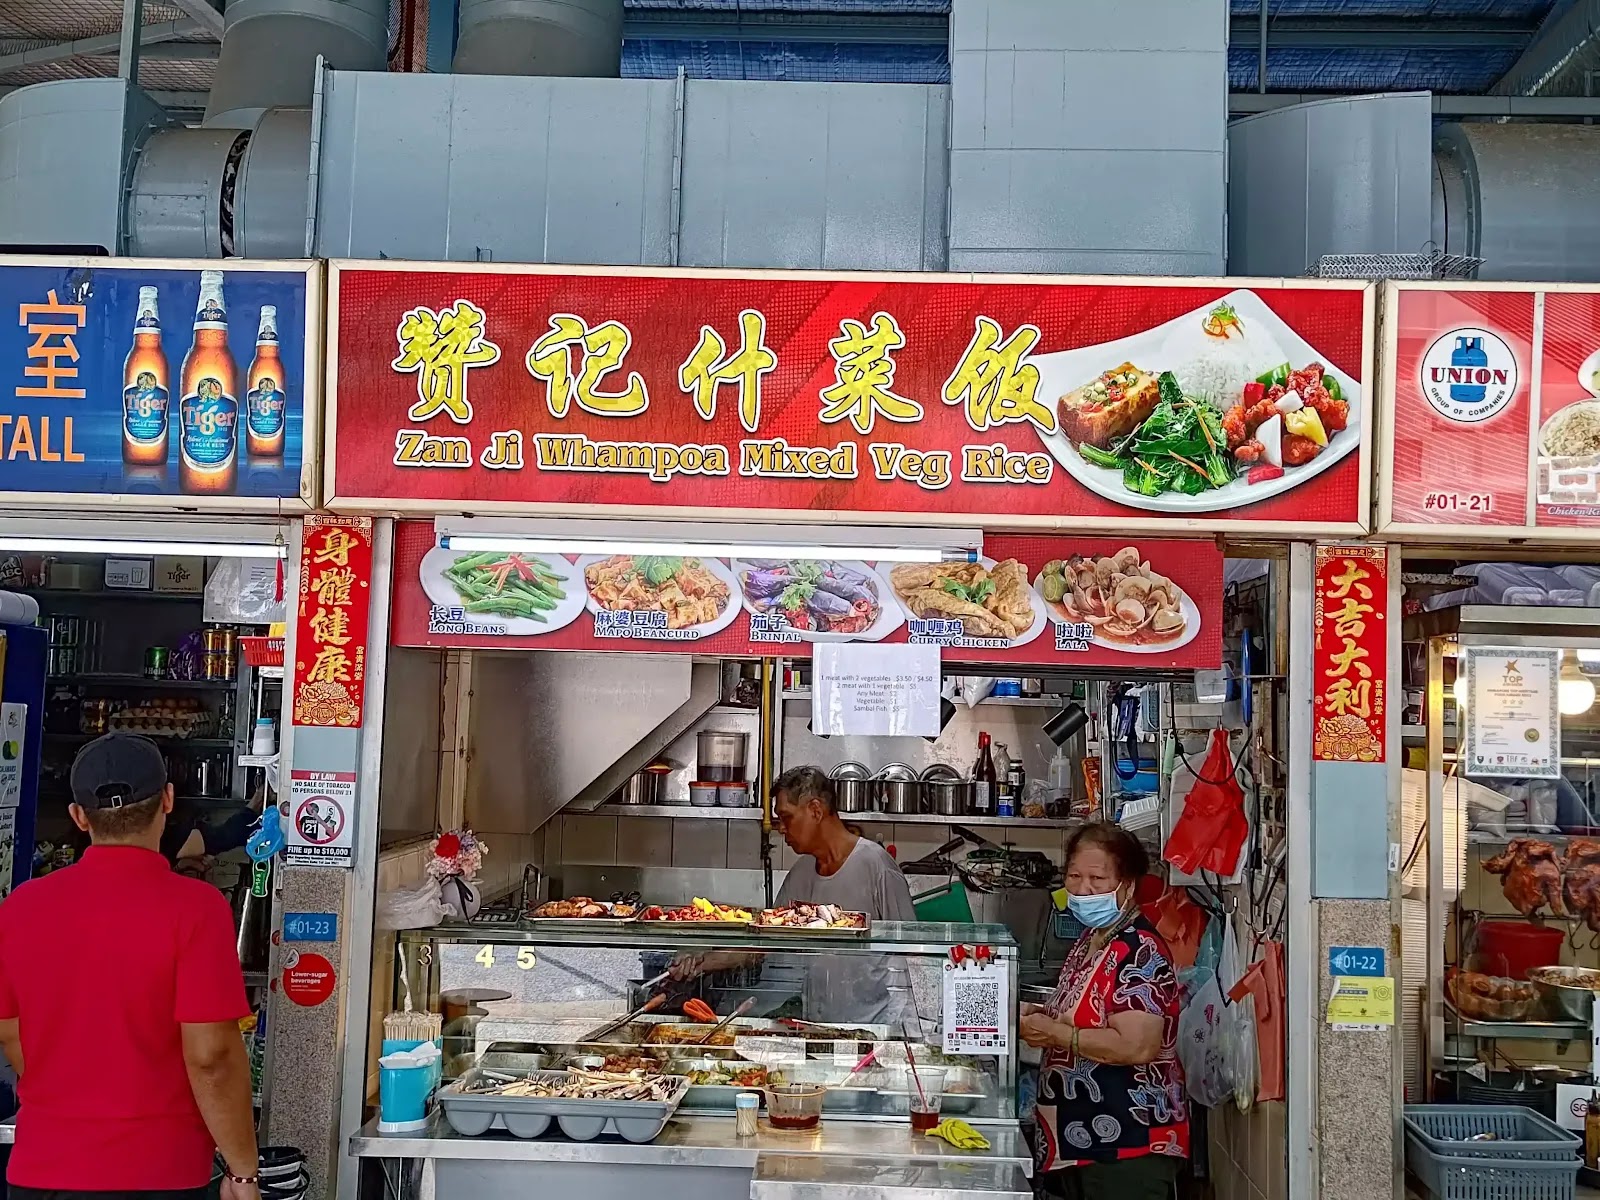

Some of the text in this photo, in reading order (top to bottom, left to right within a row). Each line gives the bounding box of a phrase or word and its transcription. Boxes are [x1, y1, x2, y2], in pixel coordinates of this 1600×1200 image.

[16, 289, 86, 399] 室
[392, 299, 1059, 435] 赞记什菜饭
[1430, 367, 1508, 385] UNION
[126, 393, 167, 417] Tiger
[250, 395, 283, 416] Tiger
[1431, 387, 1450, 408] GROUP
[1469, 389, 1505, 416] COMPANIES
[183, 405, 235, 435] Tiger
[396, 431, 1052, 487] Zan Ji Whampoa Mixed Veg Rice
[1425, 494, 1491, 511] #01-21
[306, 527, 359, 683] 身體健康
[430, 605, 465, 622] 长豆
[596, 611, 667, 627] 麻婆豆腐
[430, 623, 506, 634] LONG BEANS
[751, 615, 786, 630] 茄子
[595, 628, 700, 639] MAPO BEANCURD
[751, 631, 800, 642] BRINJAL
[1056, 623, 1093, 639] 啦啦
[1324, 559, 1374, 719] 大吉大利
[909, 636, 1009, 648] CURRY CHICKEN
[1056, 640, 1088, 650] LALA
[861, 675, 891, 683] vegetables
[1502, 675, 1523, 683] TOP
[310, 772, 320, 780] BY
[305, 824, 317, 834] 21
[287, 846, 303, 854] FINE
[314, 847, 321, 855] to
[289, 921, 329, 934] #01-23
[417, 944, 536, 970] 3 4 5
[1335, 955, 1377, 970] #01-22
